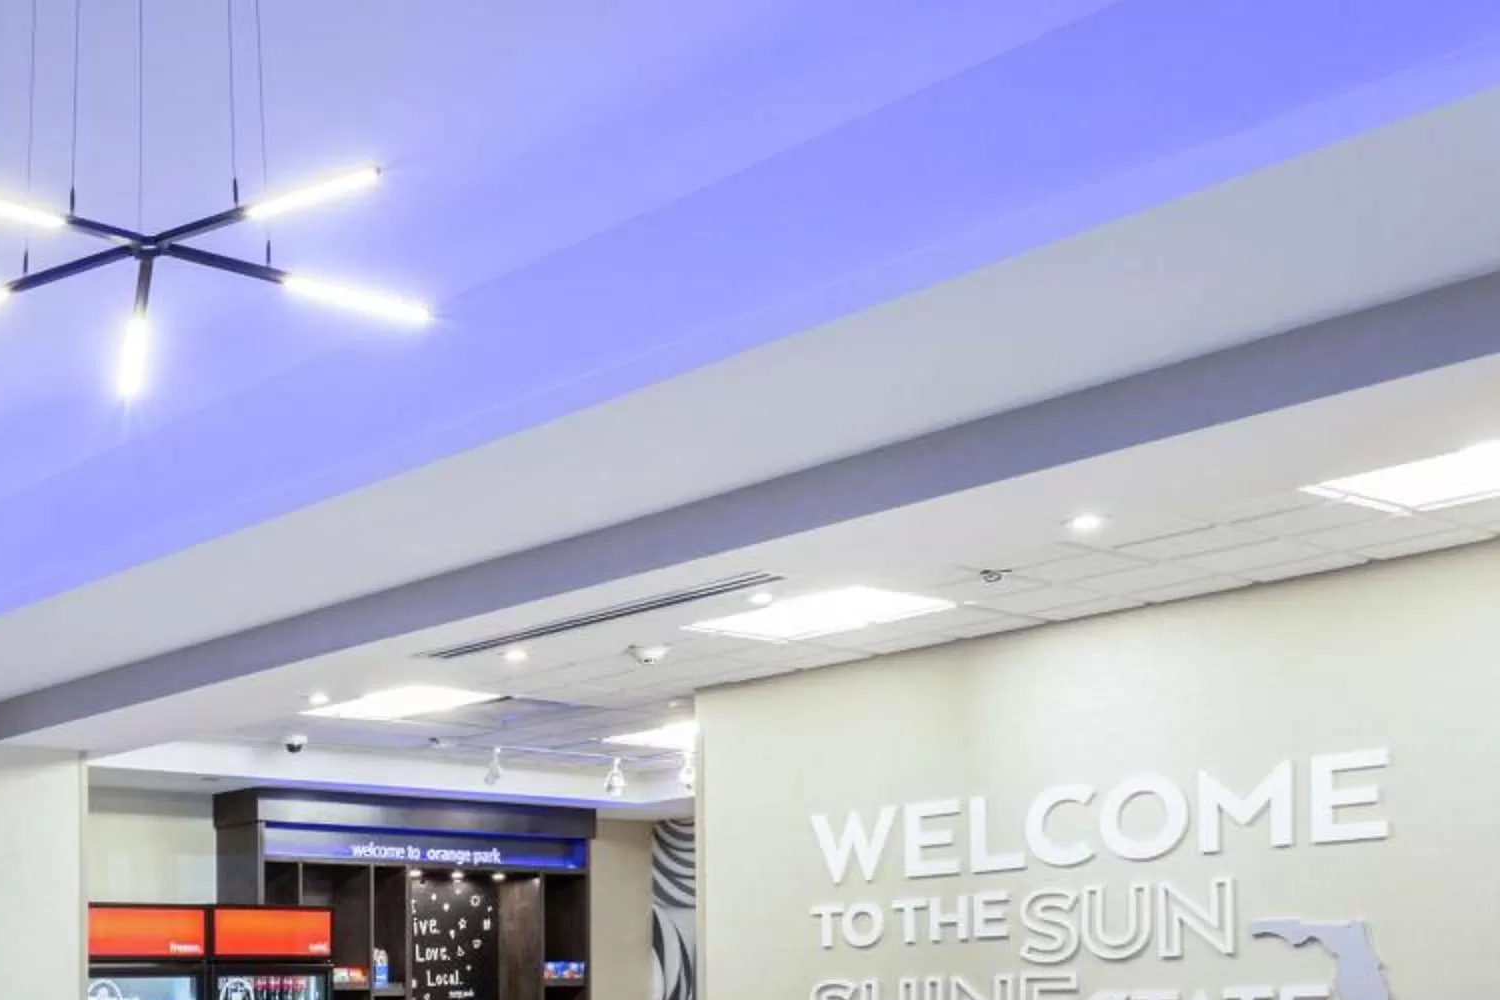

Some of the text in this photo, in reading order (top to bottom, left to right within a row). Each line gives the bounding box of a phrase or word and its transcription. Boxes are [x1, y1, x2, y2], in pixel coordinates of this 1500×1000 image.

[351, 841, 501, 866] welcome to orange park
[809, 747, 1391, 885] WELCOME
[809, 876, 1238, 965] TO THE SUN
